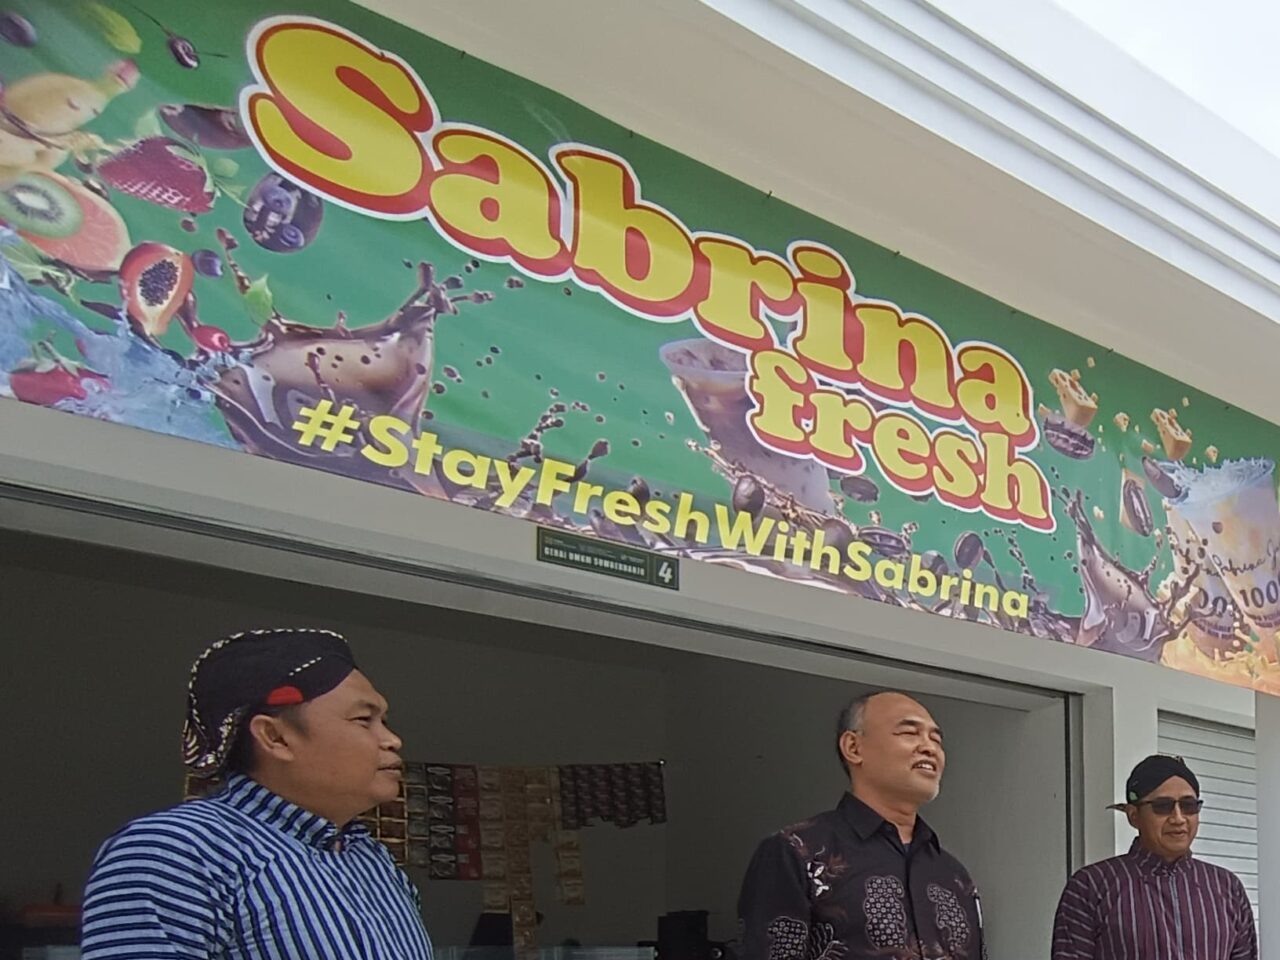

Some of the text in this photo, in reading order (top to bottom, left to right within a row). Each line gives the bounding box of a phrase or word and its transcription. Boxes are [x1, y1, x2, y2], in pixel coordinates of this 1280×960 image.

[241, 15, 1035, 451] Sabrina
[292, 399, 1030, 620] #StayFreshWithSabrina
[746, 345, 1057, 531] fresh
[658, 561, 673, 584] 4
